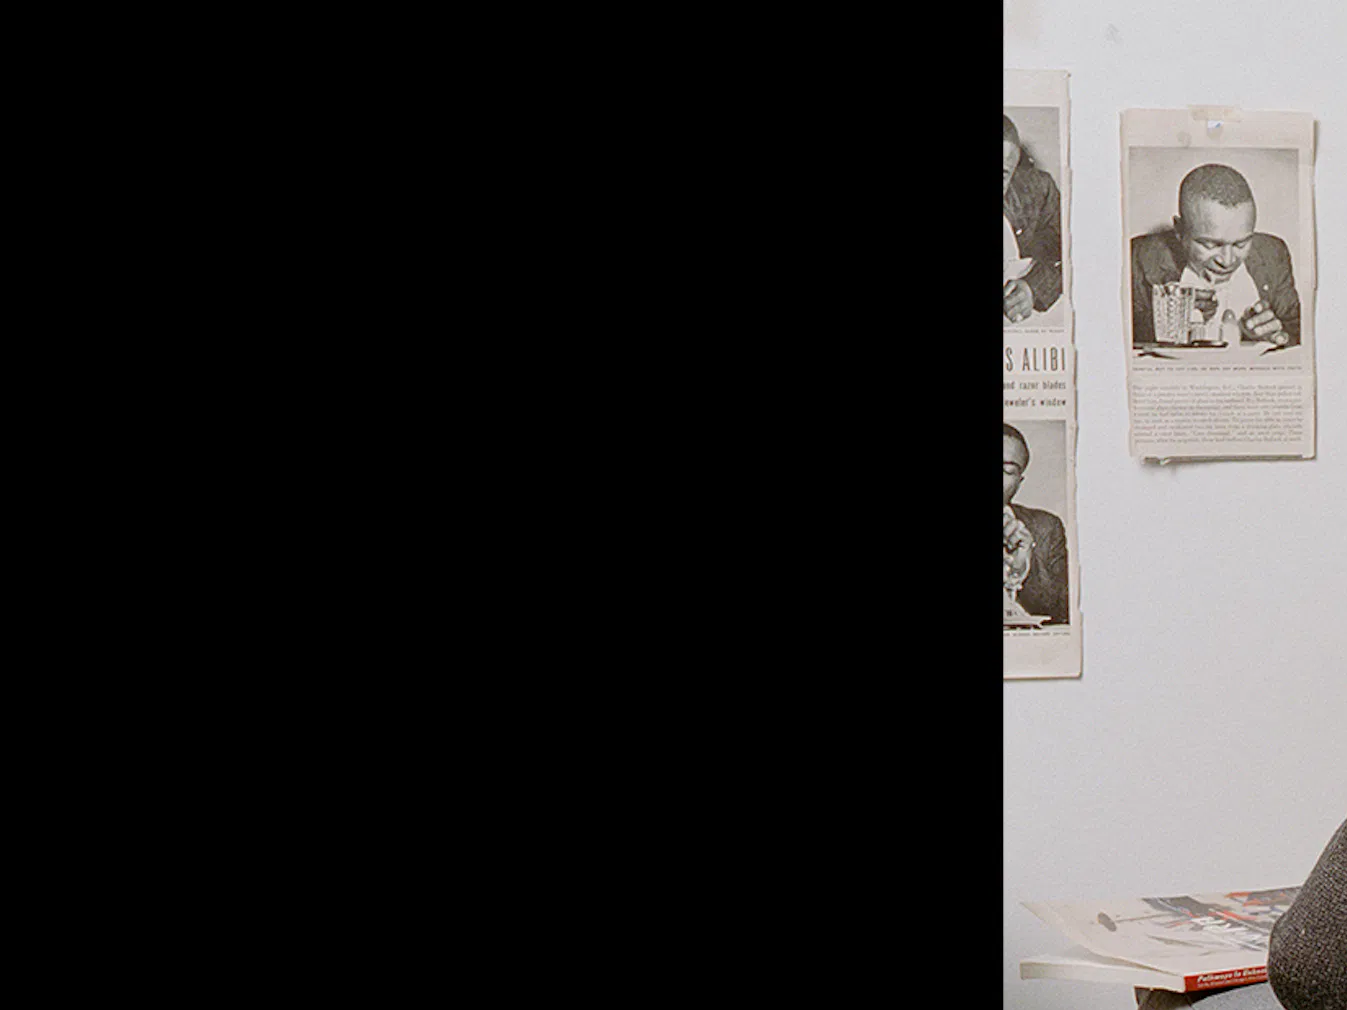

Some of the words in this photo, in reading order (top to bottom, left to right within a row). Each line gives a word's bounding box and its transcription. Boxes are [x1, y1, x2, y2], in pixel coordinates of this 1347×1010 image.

[1022, 347, 1065, 372] ALIBI
[1019, 382, 1038, 390] razor
[1043, 381, 1066, 390] blades
[1040, 398, 1067, 406] window
